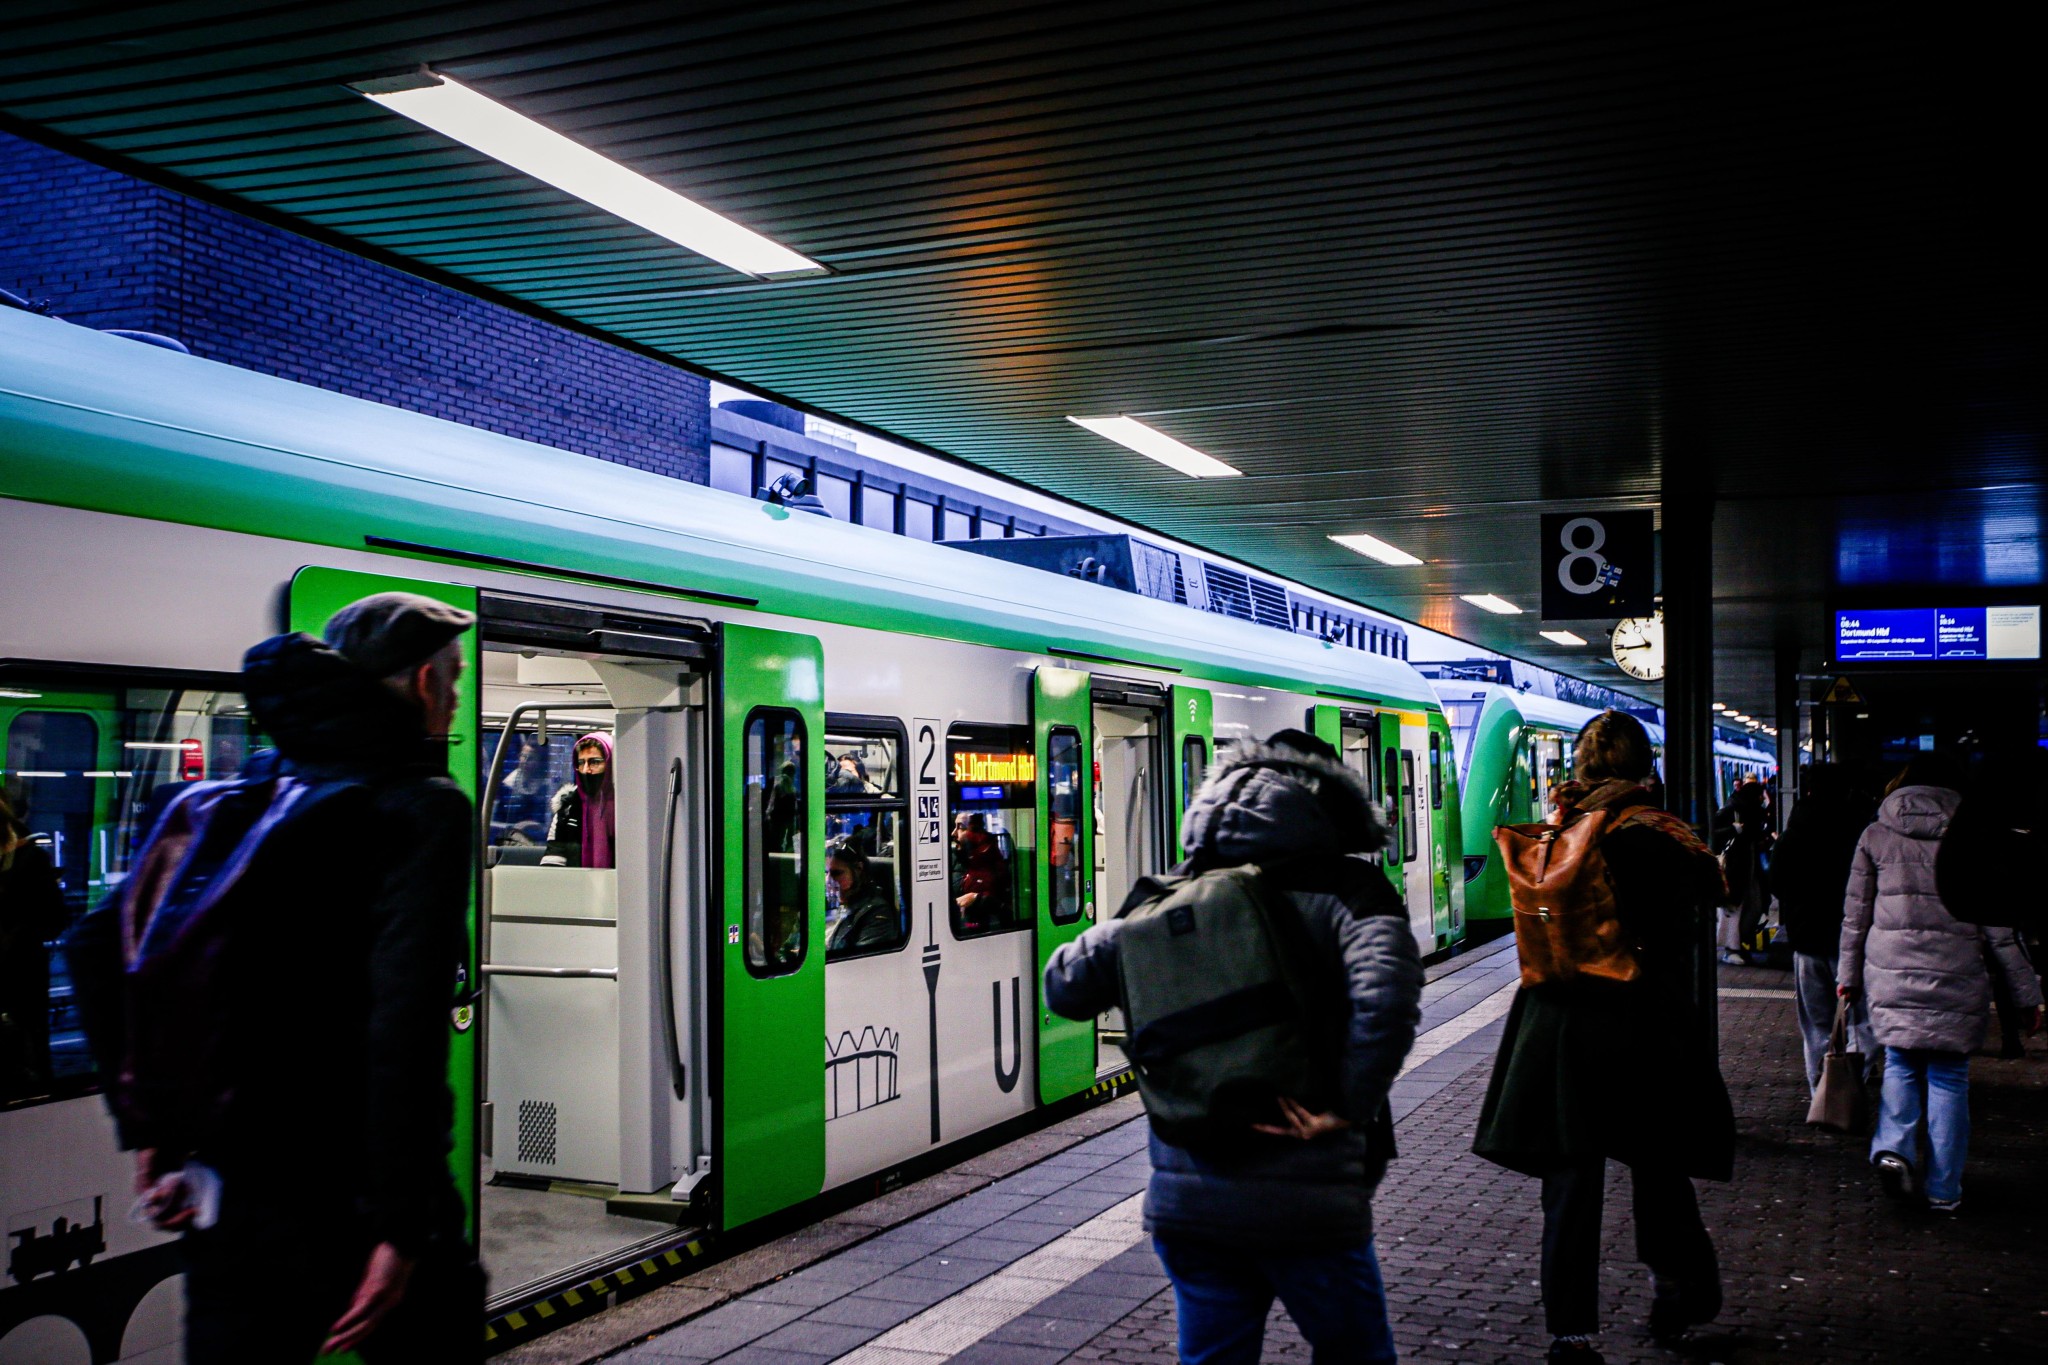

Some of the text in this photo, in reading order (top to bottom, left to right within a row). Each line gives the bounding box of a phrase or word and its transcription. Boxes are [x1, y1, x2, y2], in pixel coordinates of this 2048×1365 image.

[1558, 517, 1607, 595] 8
[1840, 627, 1890, 637] Dortmund Hbf
[919, 725, 936, 784] 2
[954, 753, 1034, 782] S1 Dortmund Hbf
